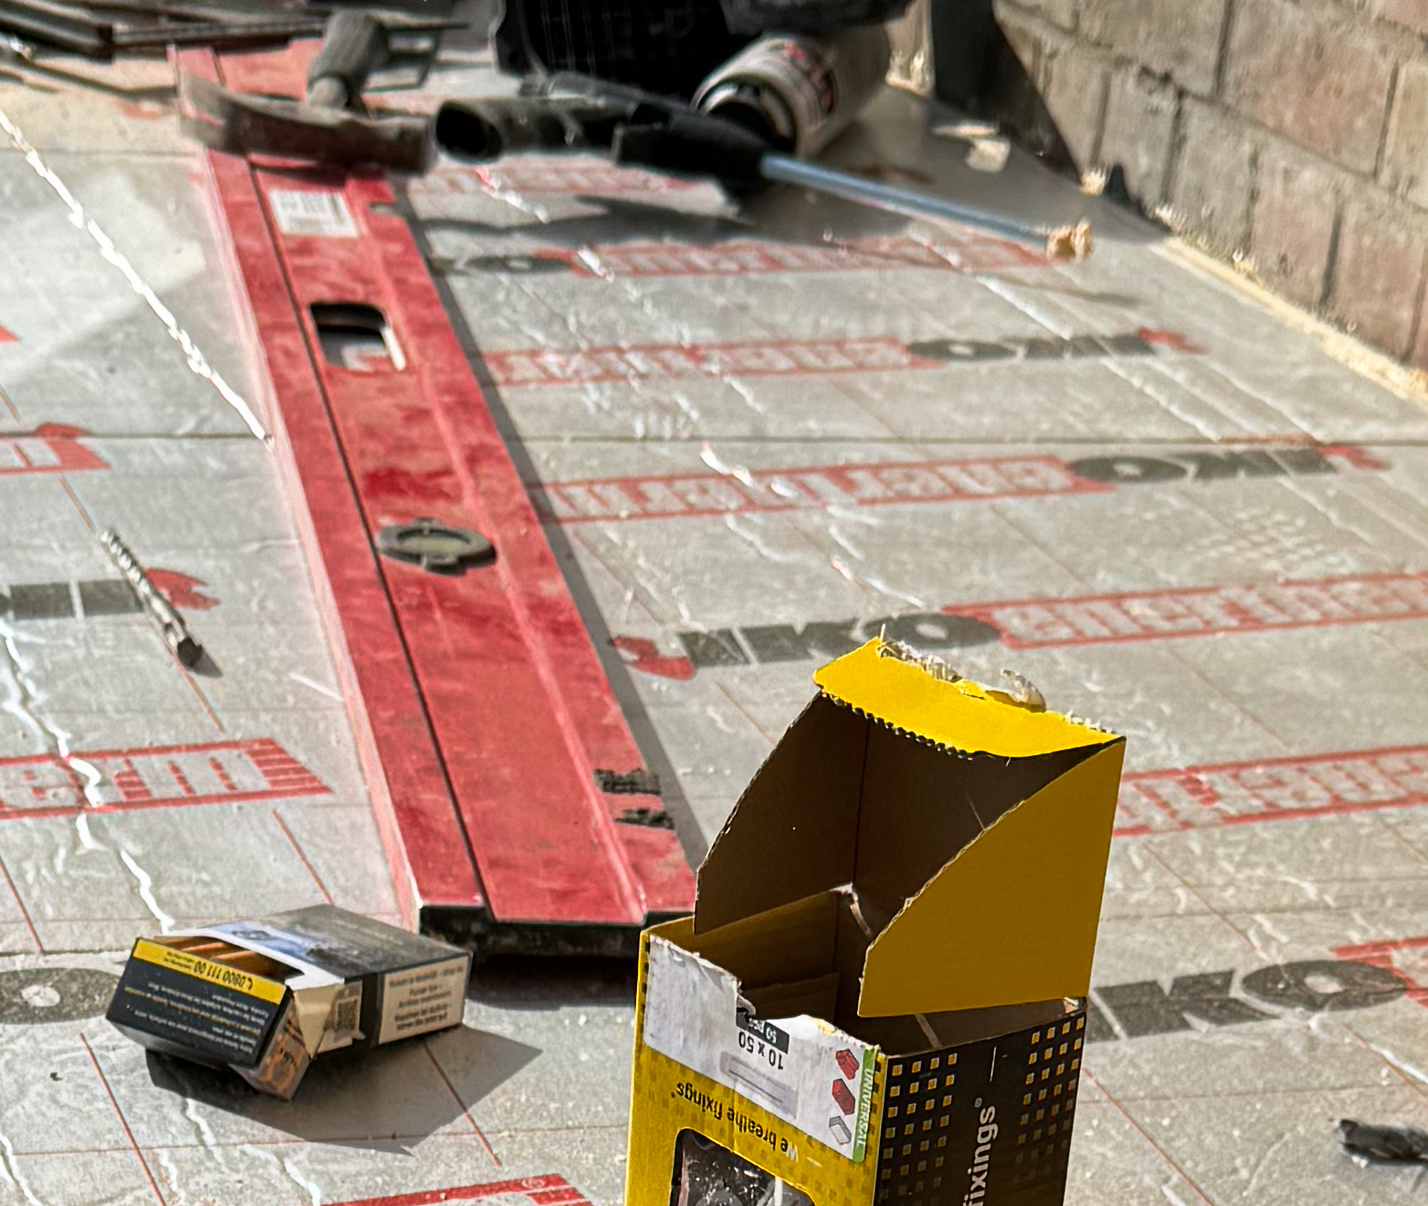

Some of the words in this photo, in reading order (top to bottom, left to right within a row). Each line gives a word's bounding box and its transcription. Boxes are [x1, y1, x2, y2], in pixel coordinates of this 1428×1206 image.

[207, 963, 221, 979] 111
[738, 1031, 755, 1055] 50
[757, 1040, 766, 1057] x
[768, 1051, 785, 1071] 10
[856, 1068, 875, 1149] UNIVERSAL
[726, 1108, 778, 1151] breathe
[781, 1141, 799, 1162] We
